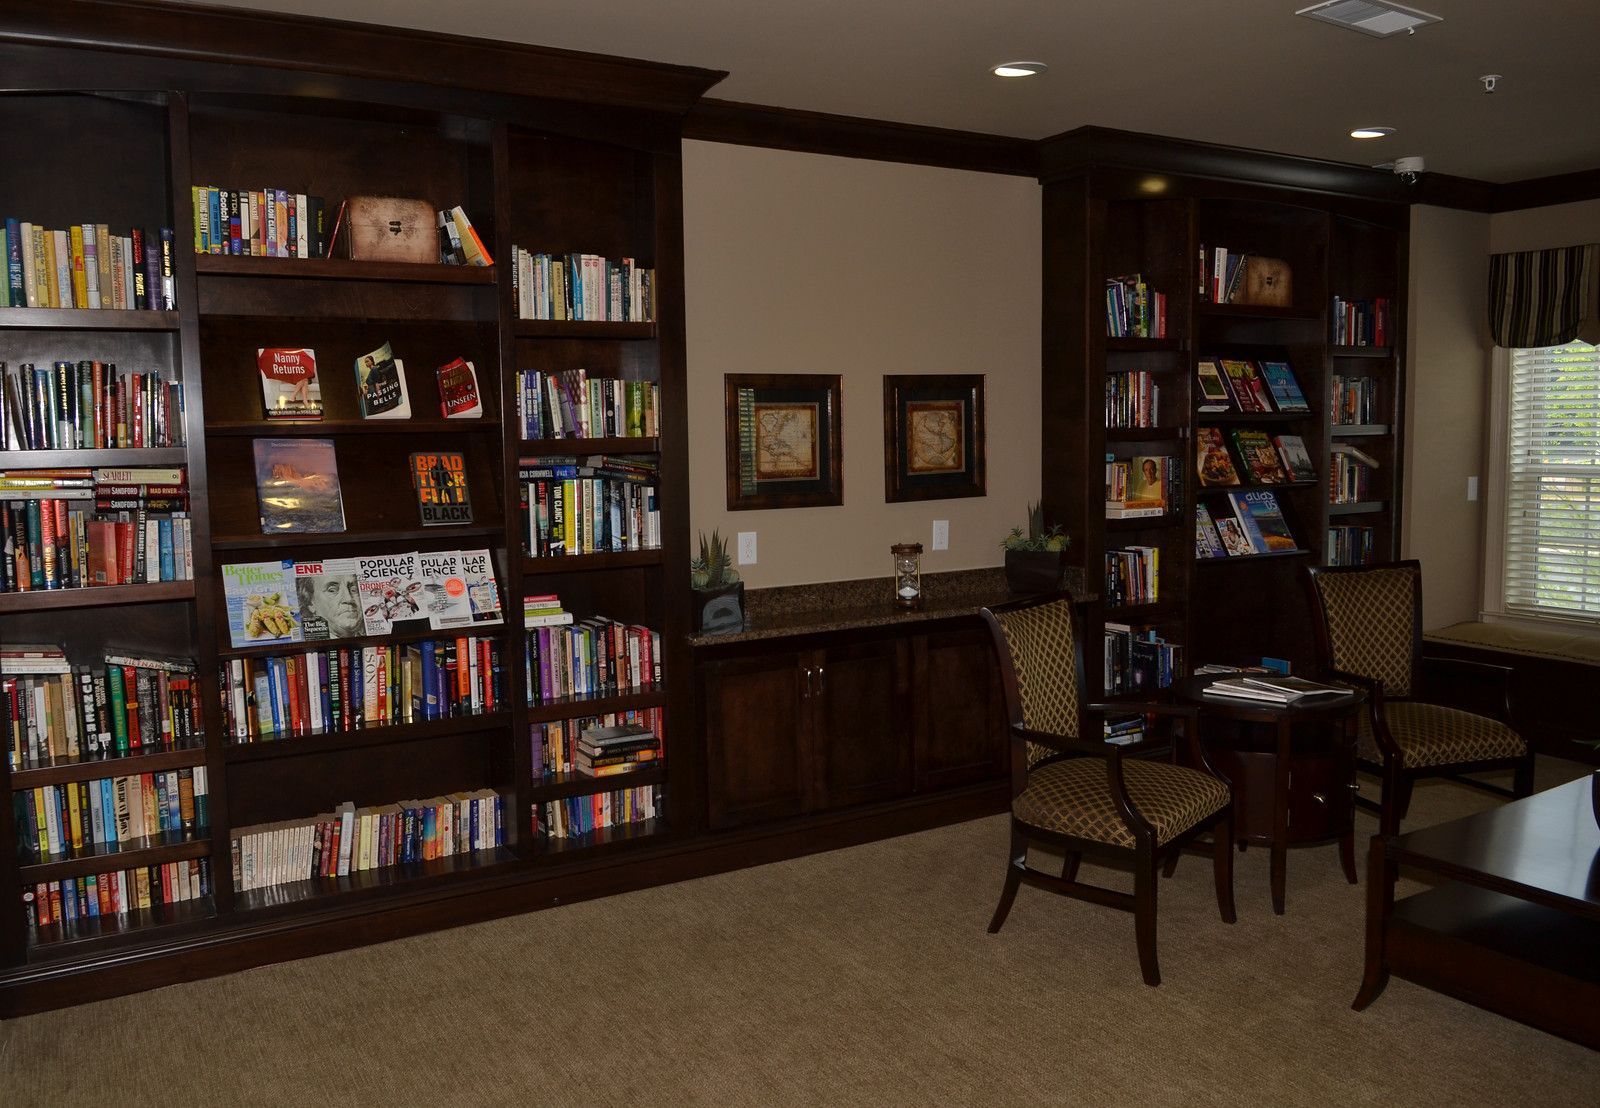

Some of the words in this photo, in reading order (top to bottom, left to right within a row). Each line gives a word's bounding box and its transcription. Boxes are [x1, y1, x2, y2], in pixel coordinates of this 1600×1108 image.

[198, 189, 208, 213] BOATING
[220, 191, 229, 221] Scotch
[200, 213, 210, 234] SAFETY
[268, 221, 276, 240] CLINIC
[10, 274, 22, 290] SPIRE
[135, 272, 145, 297] PRIVATE
[274, 352, 300, 365] Nanny
[273, 363, 305, 374] Returns
[366, 381, 399, 400] PASSING
[372, 391, 398, 405] BELLS
[447, 392, 477, 408] UNSEEN
[416, 454, 463, 471] BRAD
[529, 469, 553, 478] CORNWELL
[111, 486, 138, 495] SANDFORD
[150, 487, 162, 495] MAD
[554, 485, 562, 499] TOM
[1245, 490, 1274, 502] atlas
[110, 500, 138, 509] SANDFORD
[422, 506, 471, 520] BLACK
[554, 500, 563, 524] CLANCY
[295, 564, 323, 575] ENR
[360, 557, 414, 569] POPULAR
[225, 565, 263, 577] Better
[363, 566, 414, 579] SCIENCE
[239, 571, 284, 586] Homes
[360, 581, 390, 591] DRONES
[316, 621, 328, 629] Big
[330, 650, 338, 659] THE
[122, 658, 161, 670] VIETNAM
[330, 660, 339, 682] MIRACLE
[116, 777, 128, 812] AMERICAN
[118, 812, 130, 835] BOYS
